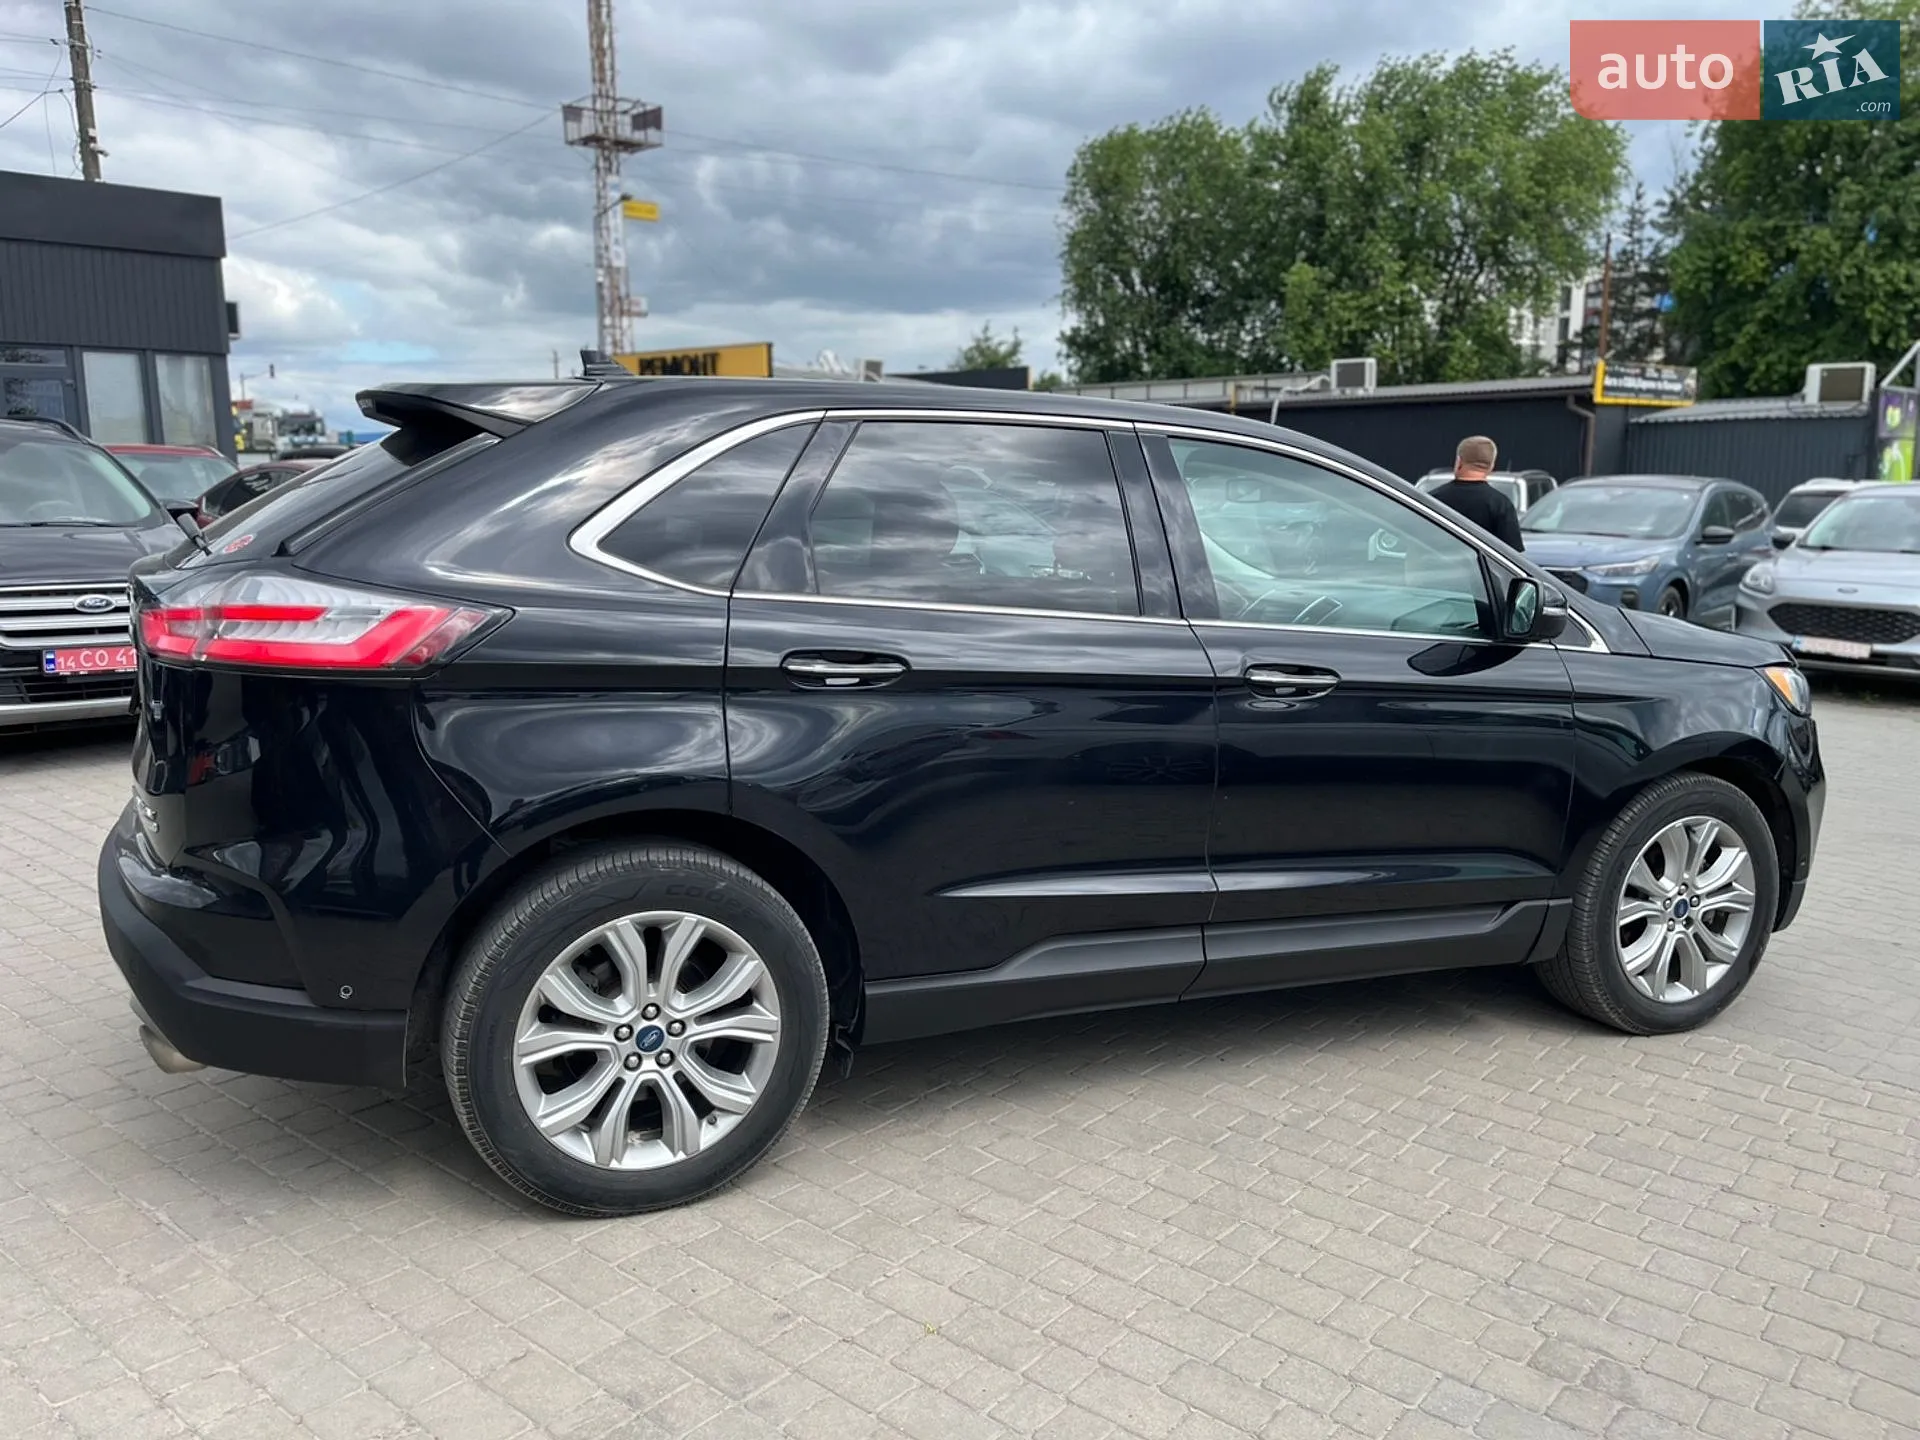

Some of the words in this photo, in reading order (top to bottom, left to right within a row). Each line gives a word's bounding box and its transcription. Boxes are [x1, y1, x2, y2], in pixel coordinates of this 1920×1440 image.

[639, 352, 720, 376] РЕМОНТ
[57, 656, 76, 669] 14
[80, 649, 109, 667] CO
